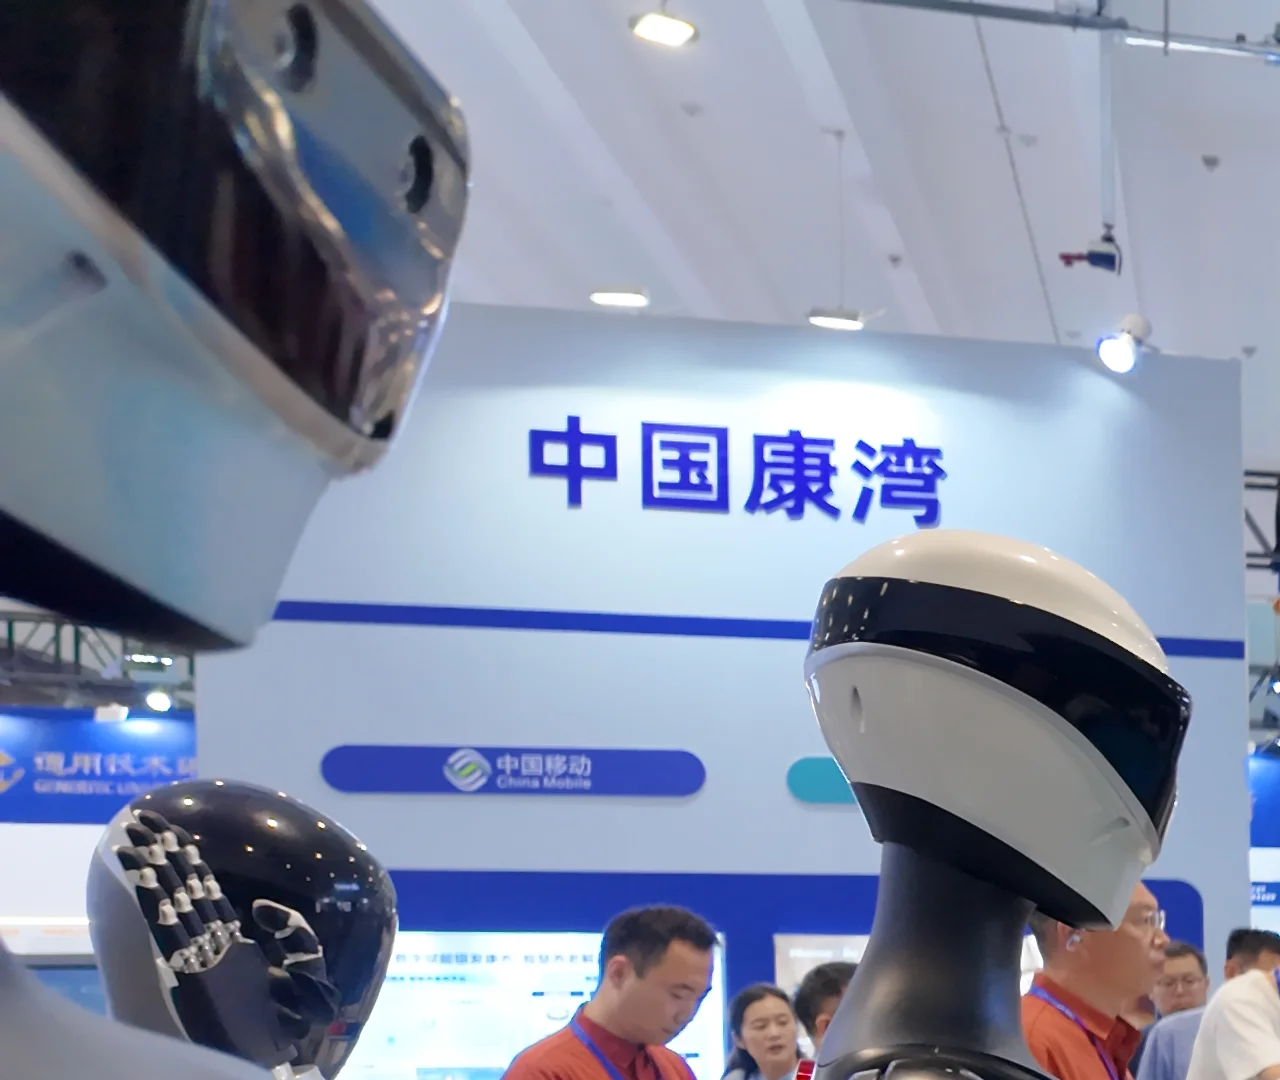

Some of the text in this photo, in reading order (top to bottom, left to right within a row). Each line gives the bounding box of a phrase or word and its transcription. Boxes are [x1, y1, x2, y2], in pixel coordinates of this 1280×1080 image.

[529, 415, 948, 528] 中国康湾
[496, 753, 592, 777] 中国移动
[496, 775, 592, 790] China Mobile
